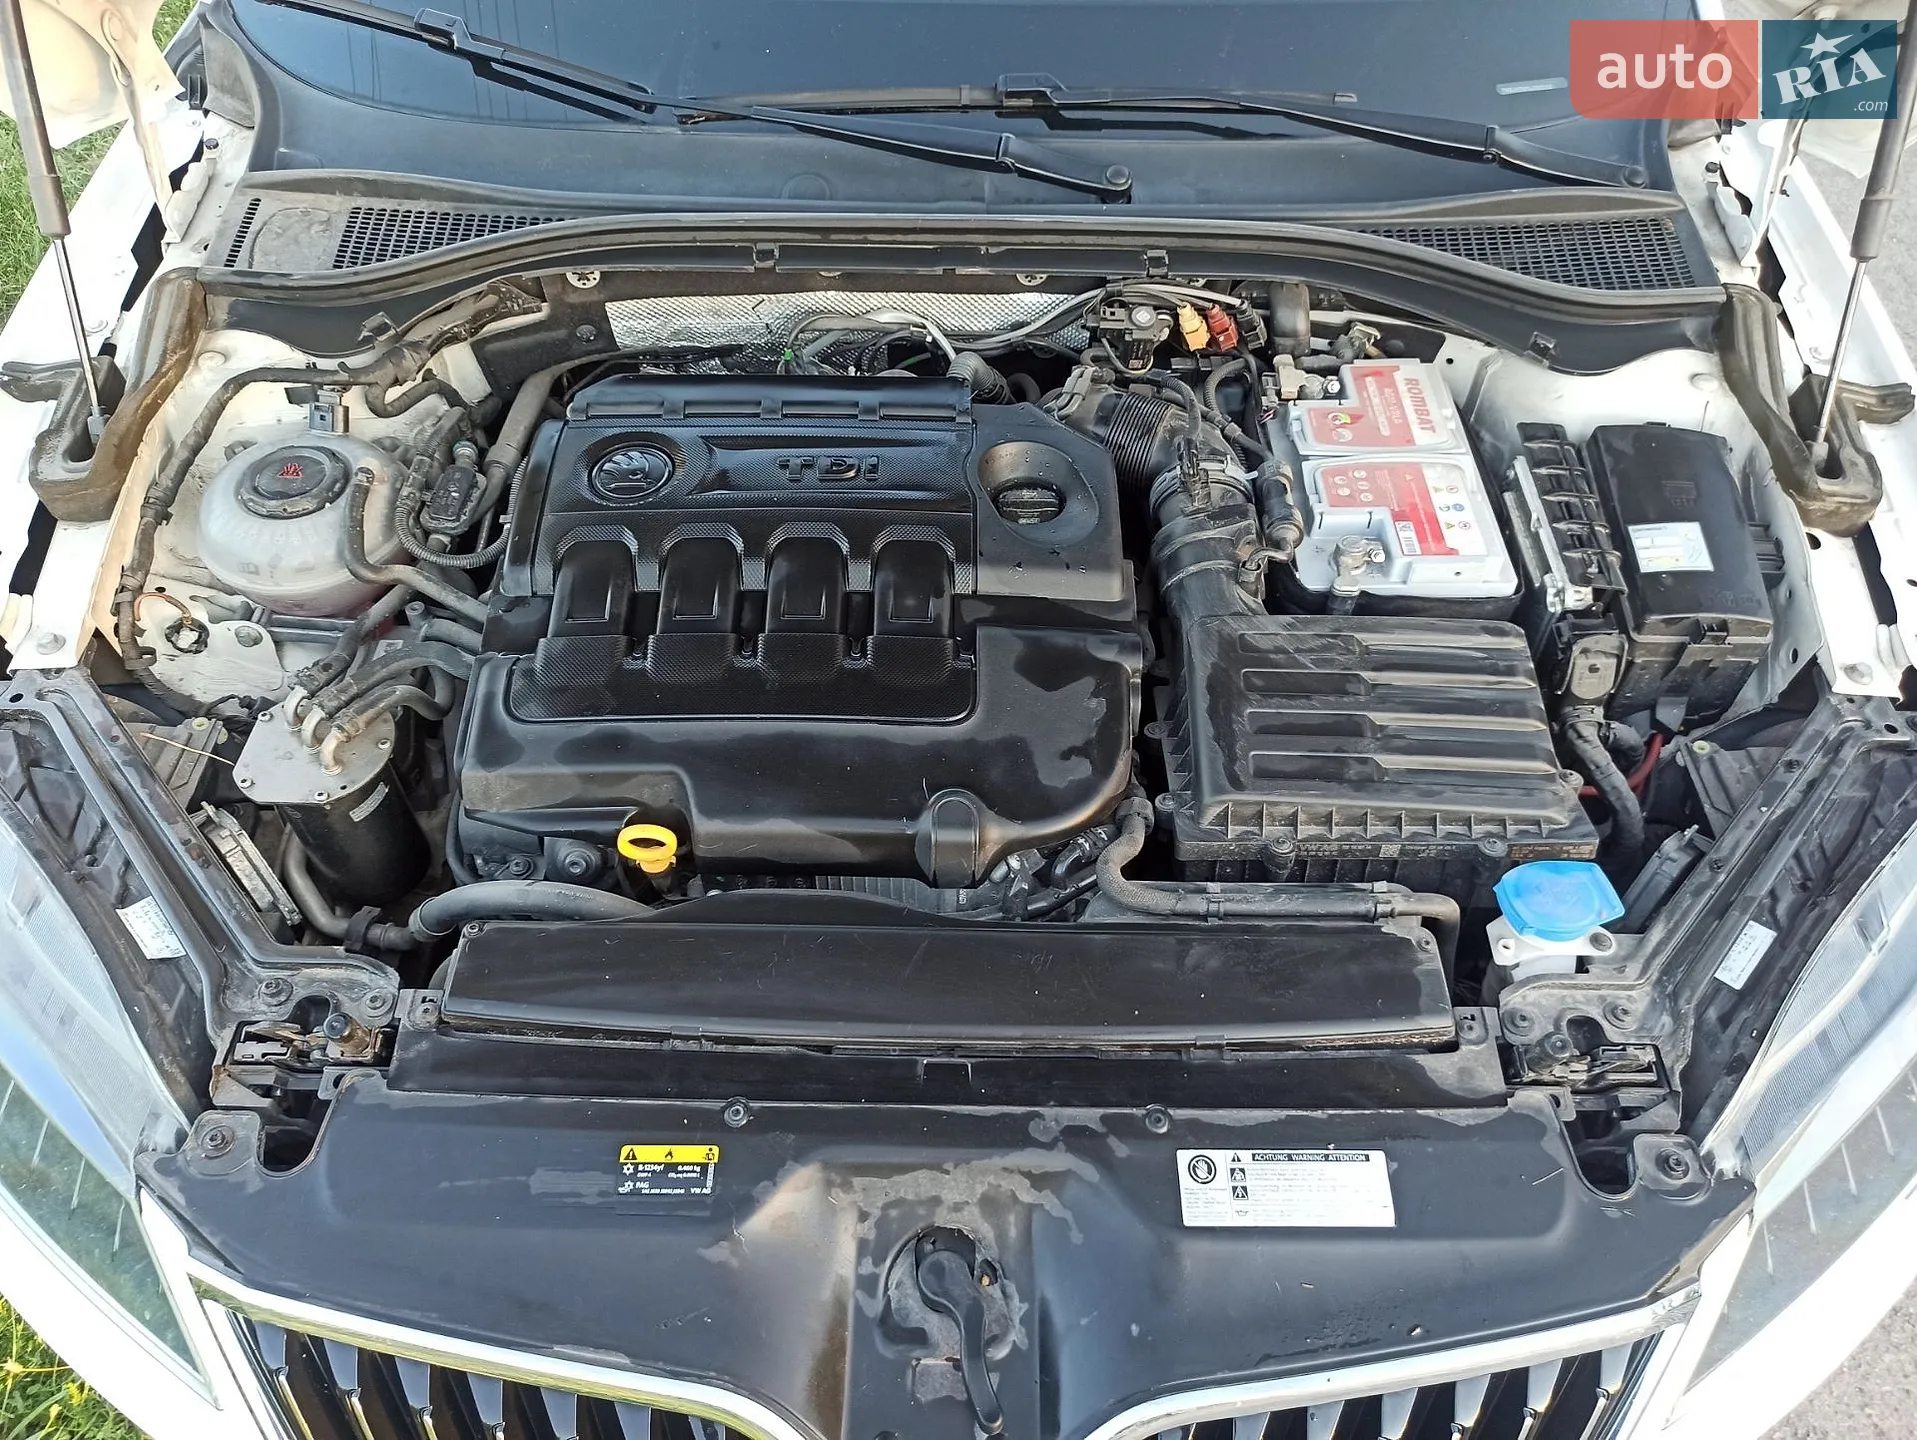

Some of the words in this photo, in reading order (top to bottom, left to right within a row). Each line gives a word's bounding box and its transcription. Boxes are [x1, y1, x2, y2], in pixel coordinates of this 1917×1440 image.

[1403, 376, 1437, 434] ROMBAT
[776, 456, 881, 481] TDI
[1253, 1153, 1289, 1162] ACHTUNG
[1291, 1154, 1326, 1162] WARNING
[1328, 1154, 1366, 1162] ATTENTION
[635, 1181, 650, 1189] PAG
